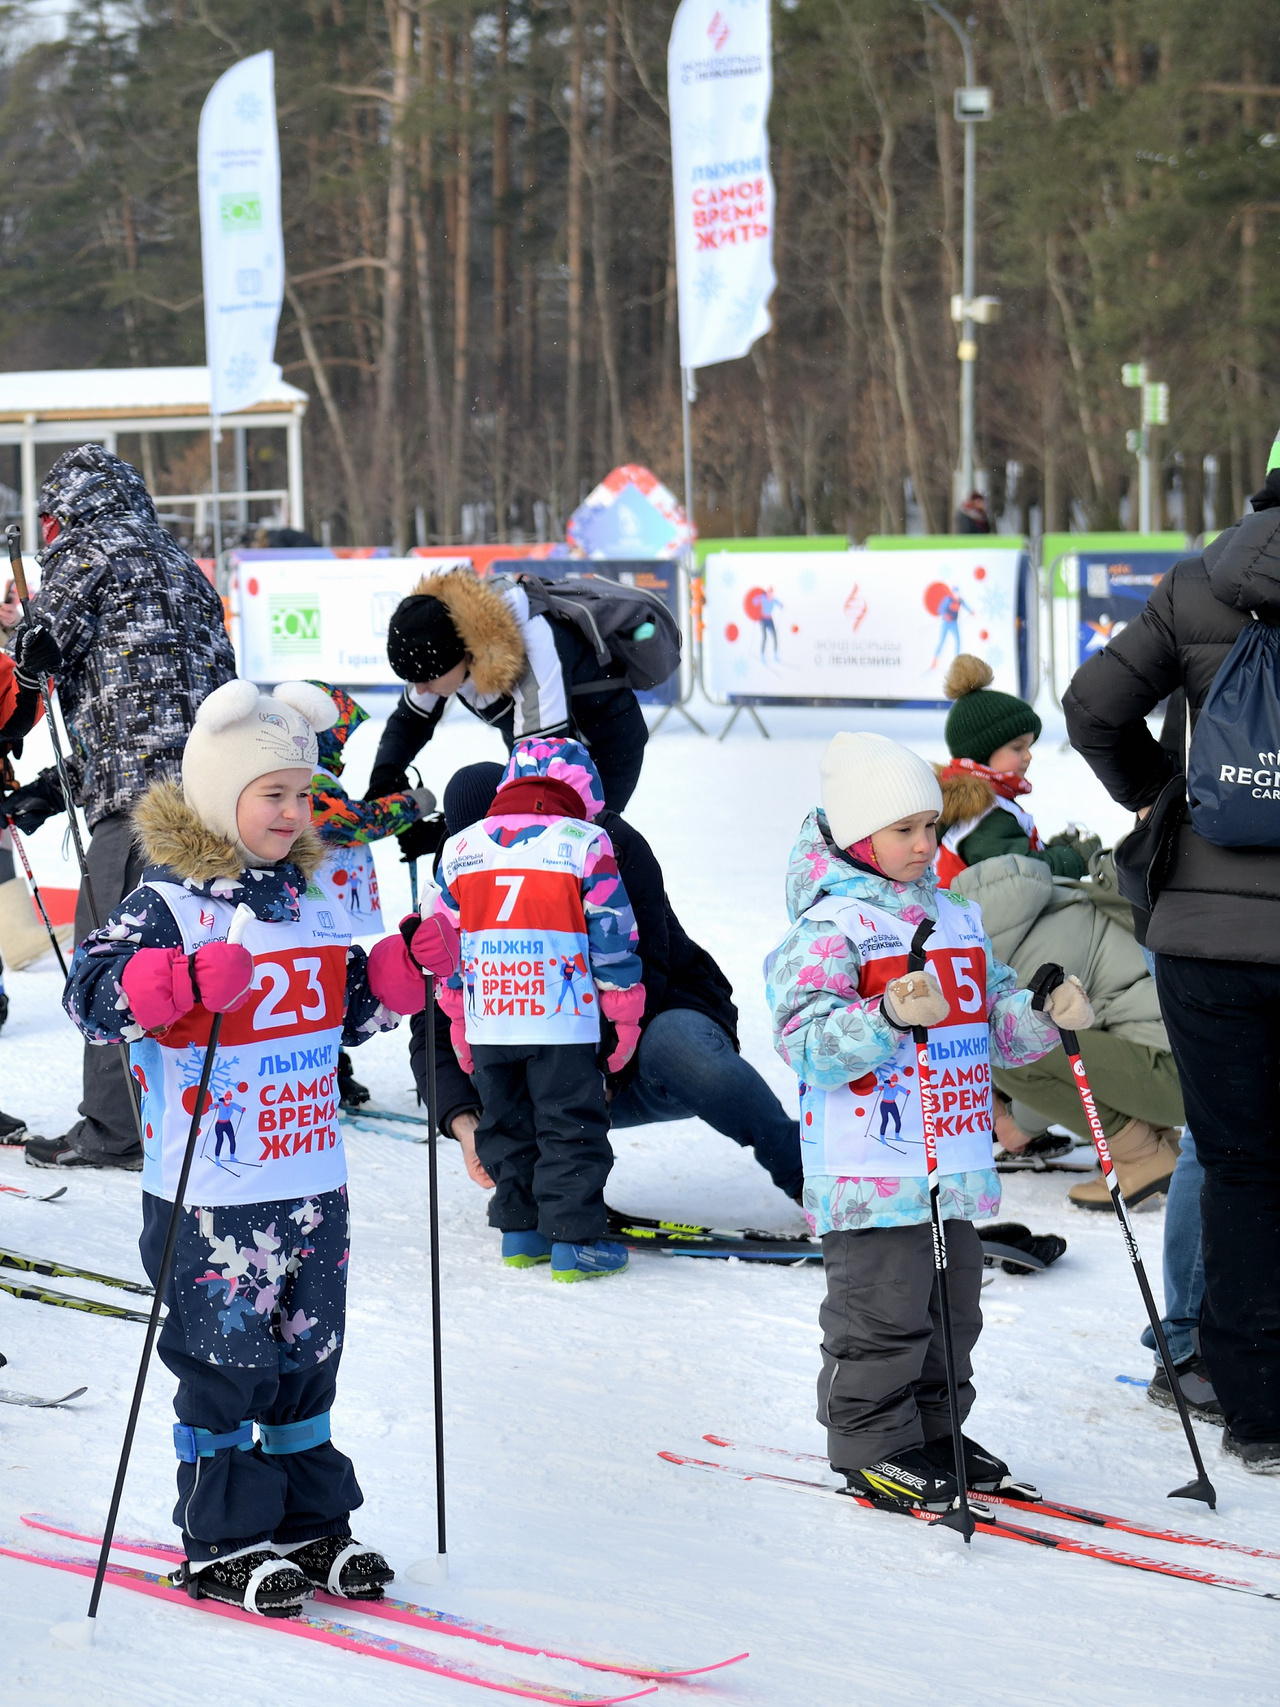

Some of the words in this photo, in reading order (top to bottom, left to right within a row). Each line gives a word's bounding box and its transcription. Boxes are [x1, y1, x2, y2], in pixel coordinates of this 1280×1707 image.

[691, 157, 763, 183] ЛЫЖНЯ
[693, 179, 763, 206] САМОЕ
[693, 201, 766, 228] ВРЕМЯ
[696, 224, 769, 250] ЖИТЬ
[495, 875, 525, 922] 7
[481, 940, 544, 955] ЛЫЖНЯ
[481, 961, 545, 977] САМОЕ
[252, 956, 327, 1031] 23
[482, 979, 545, 996] ВРЕМЯ
[482, 998, 546, 1016] ЖИТЬ
[929, 1063, 990, 1090] САМОЕ
[922, 1077, 937, 1160] NORDWAY
[1080, 1085, 1111, 1163] NORDWAY
[258, 1124, 336, 1161] ЖИТЬ
[931, 1221, 942, 1270] NORDWAY
[967, 1491, 1004, 1505] NORDWAY
